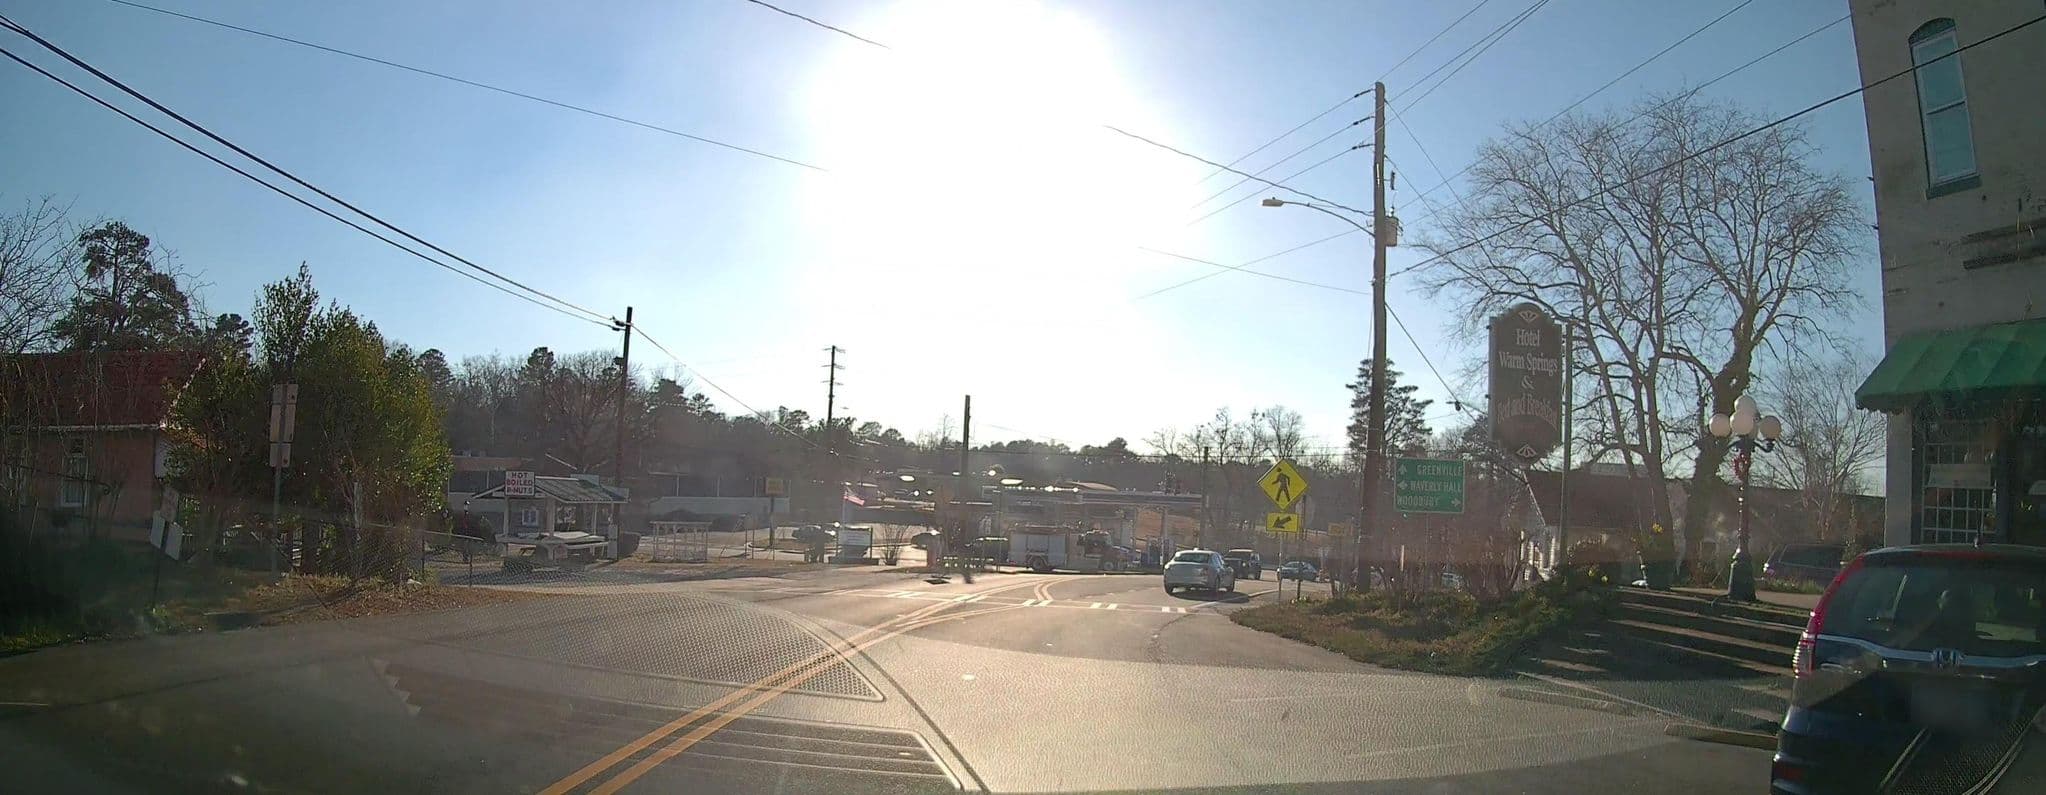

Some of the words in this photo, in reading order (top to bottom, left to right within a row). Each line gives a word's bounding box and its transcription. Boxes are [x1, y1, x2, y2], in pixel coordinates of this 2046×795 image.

[1516, 328, 1540, 346] Hotel
[1499, 351, 1525, 369] Warm
[1526, 351, 1558, 376] Springs
[1521, 375, 1535, 389] &
[1416, 464, 1462, 476] GREENVILLE
[1410, 480, 1441, 491] WAVERLY
[1443, 481, 1462, 493] HALL
[1397, 495, 1439, 506] WOODBURY
